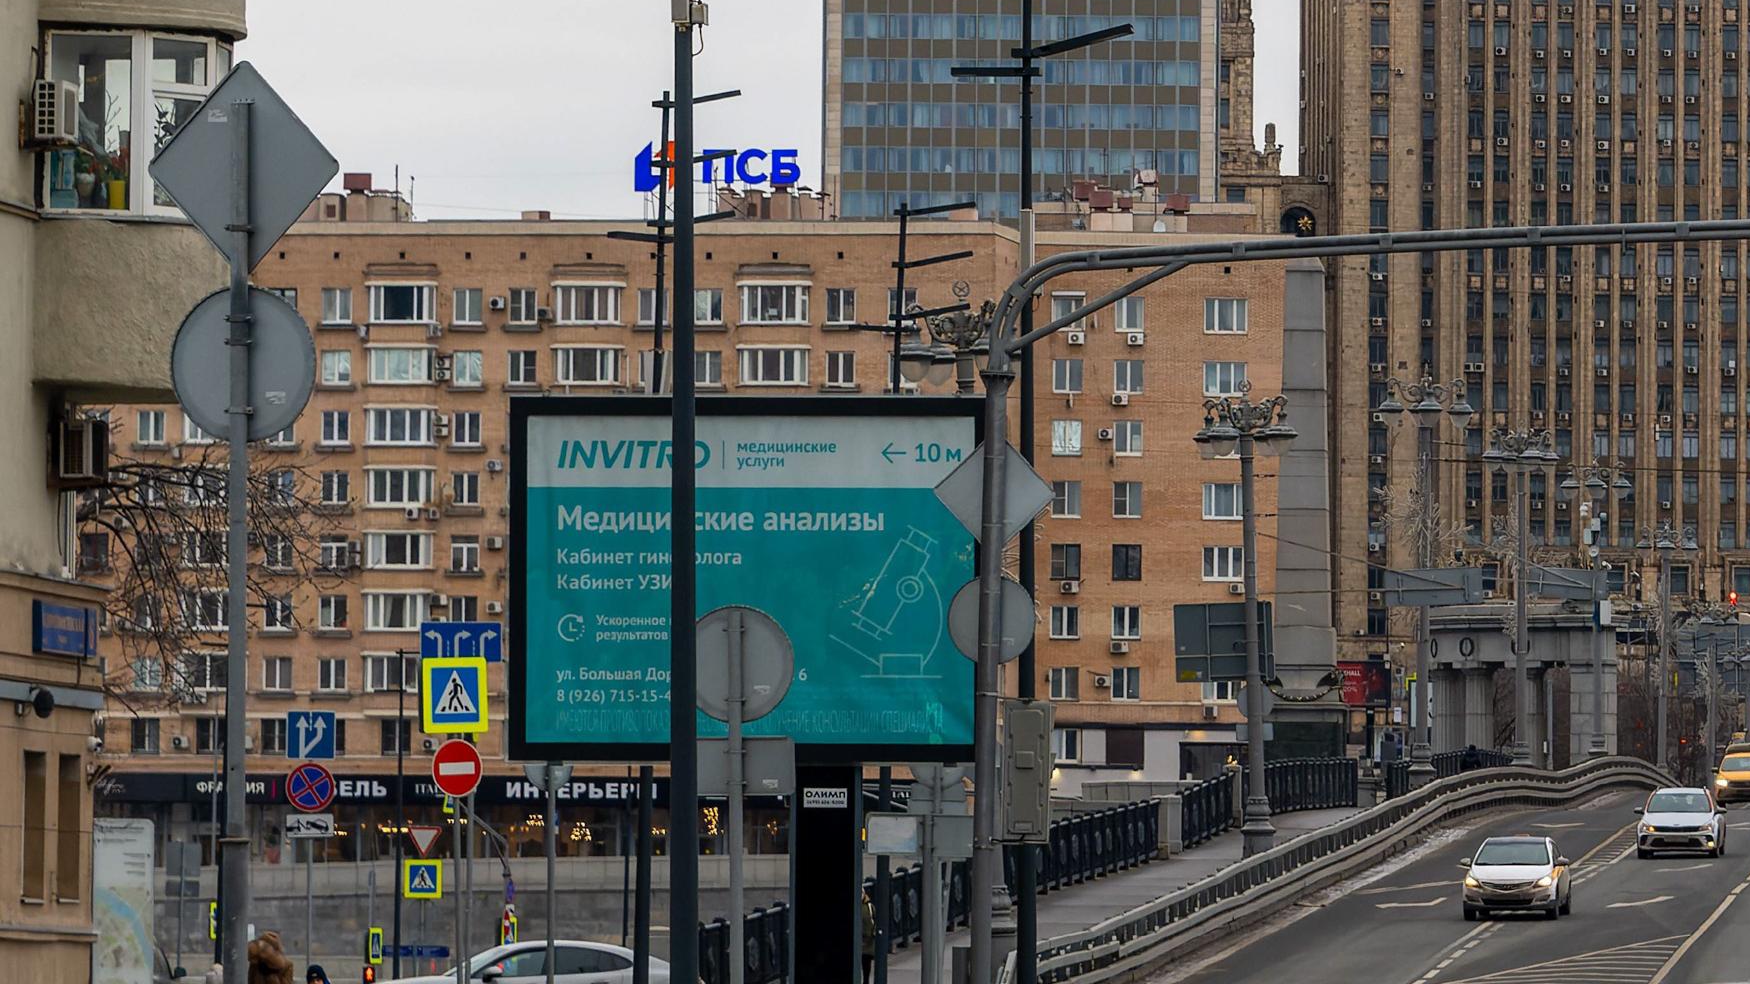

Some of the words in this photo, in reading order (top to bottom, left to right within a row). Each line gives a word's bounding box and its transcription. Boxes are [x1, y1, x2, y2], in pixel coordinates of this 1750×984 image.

[702, 149, 800, 184] ПСБ
[557, 440, 711, 469] INVITRO
[737, 441, 837, 454] медицинские
[914, 443, 941, 463] 10
[737, 456, 785, 470] услуги
[557, 504, 753, 533] Медициские
[762, 512, 885, 532] анализы
[557, 548, 634, 565] Кабинет
[639, 552, 742, 565] гинолога
[557, 574, 634, 590] Кабинет
[638, 574, 672, 590] УЗИ
[596, 615, 666, 627] Ускоренное
[596, 631, 669, 643] результатов
[556, 670, 576, 681] ул.
[579, 667, 642, 681] Большая
[556, 690, 565, 702] 8
[568, 689, 605, 704] (926)
[610, 689, 671, 702] 715-15-4
[196, 780, 265, 795] ФРАИЯ
[334, 780, 388, 797] ЕЛЬ
[506, 781, 657, 799] ИНЕРЬЕР
[805, 790, 846, 799] ОЛИМП
